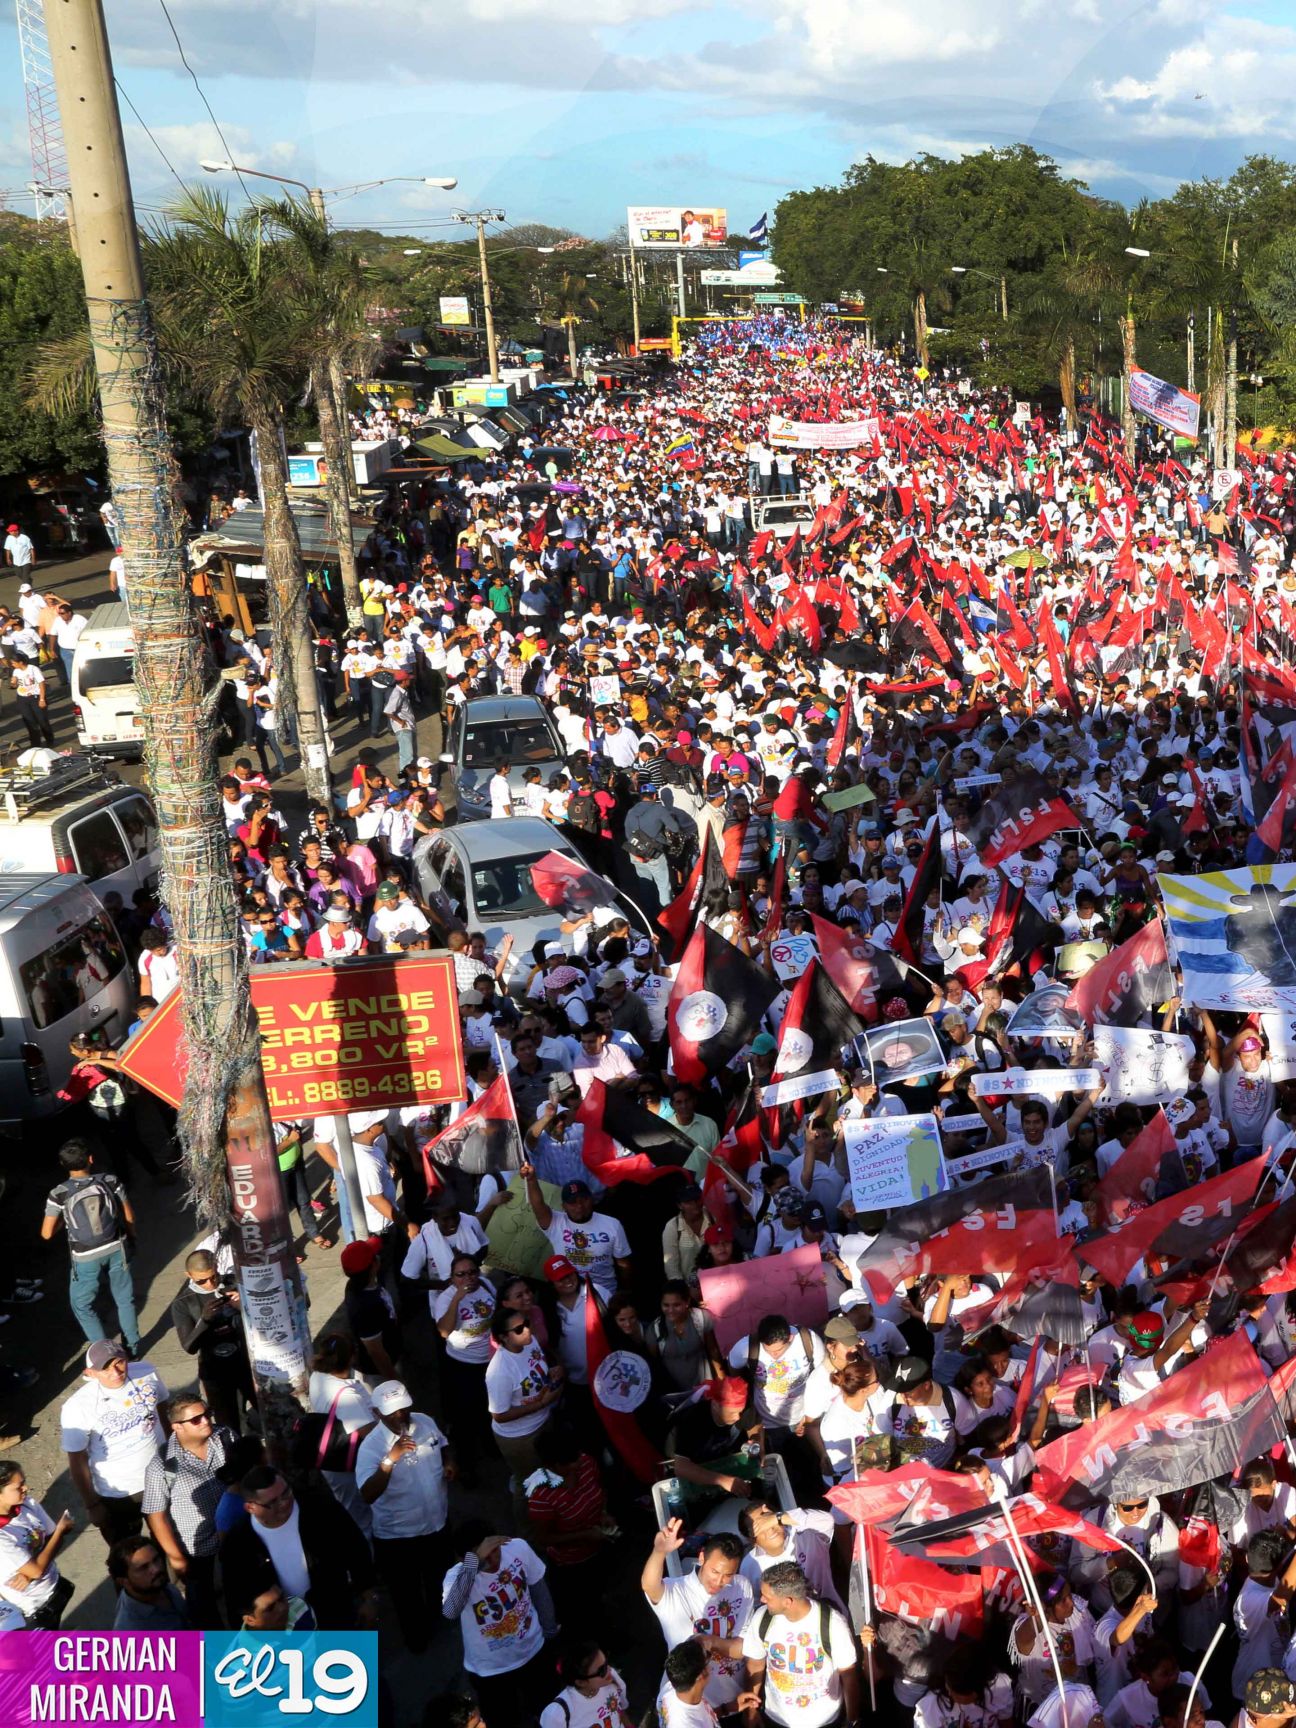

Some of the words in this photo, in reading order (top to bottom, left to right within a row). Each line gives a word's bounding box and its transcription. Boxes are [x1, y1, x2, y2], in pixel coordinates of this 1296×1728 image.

[989, 800, 1052, 849] FSLN
[289, 990, 436, 1023] VENDE
[262, 1013, 431, 1049] ERRENO
[303, 1069, 442, 1104] 8889-4326
[854, 1127, 889, 1156] PAZ!
[855, 1175, 904, 1196] VIDA!
